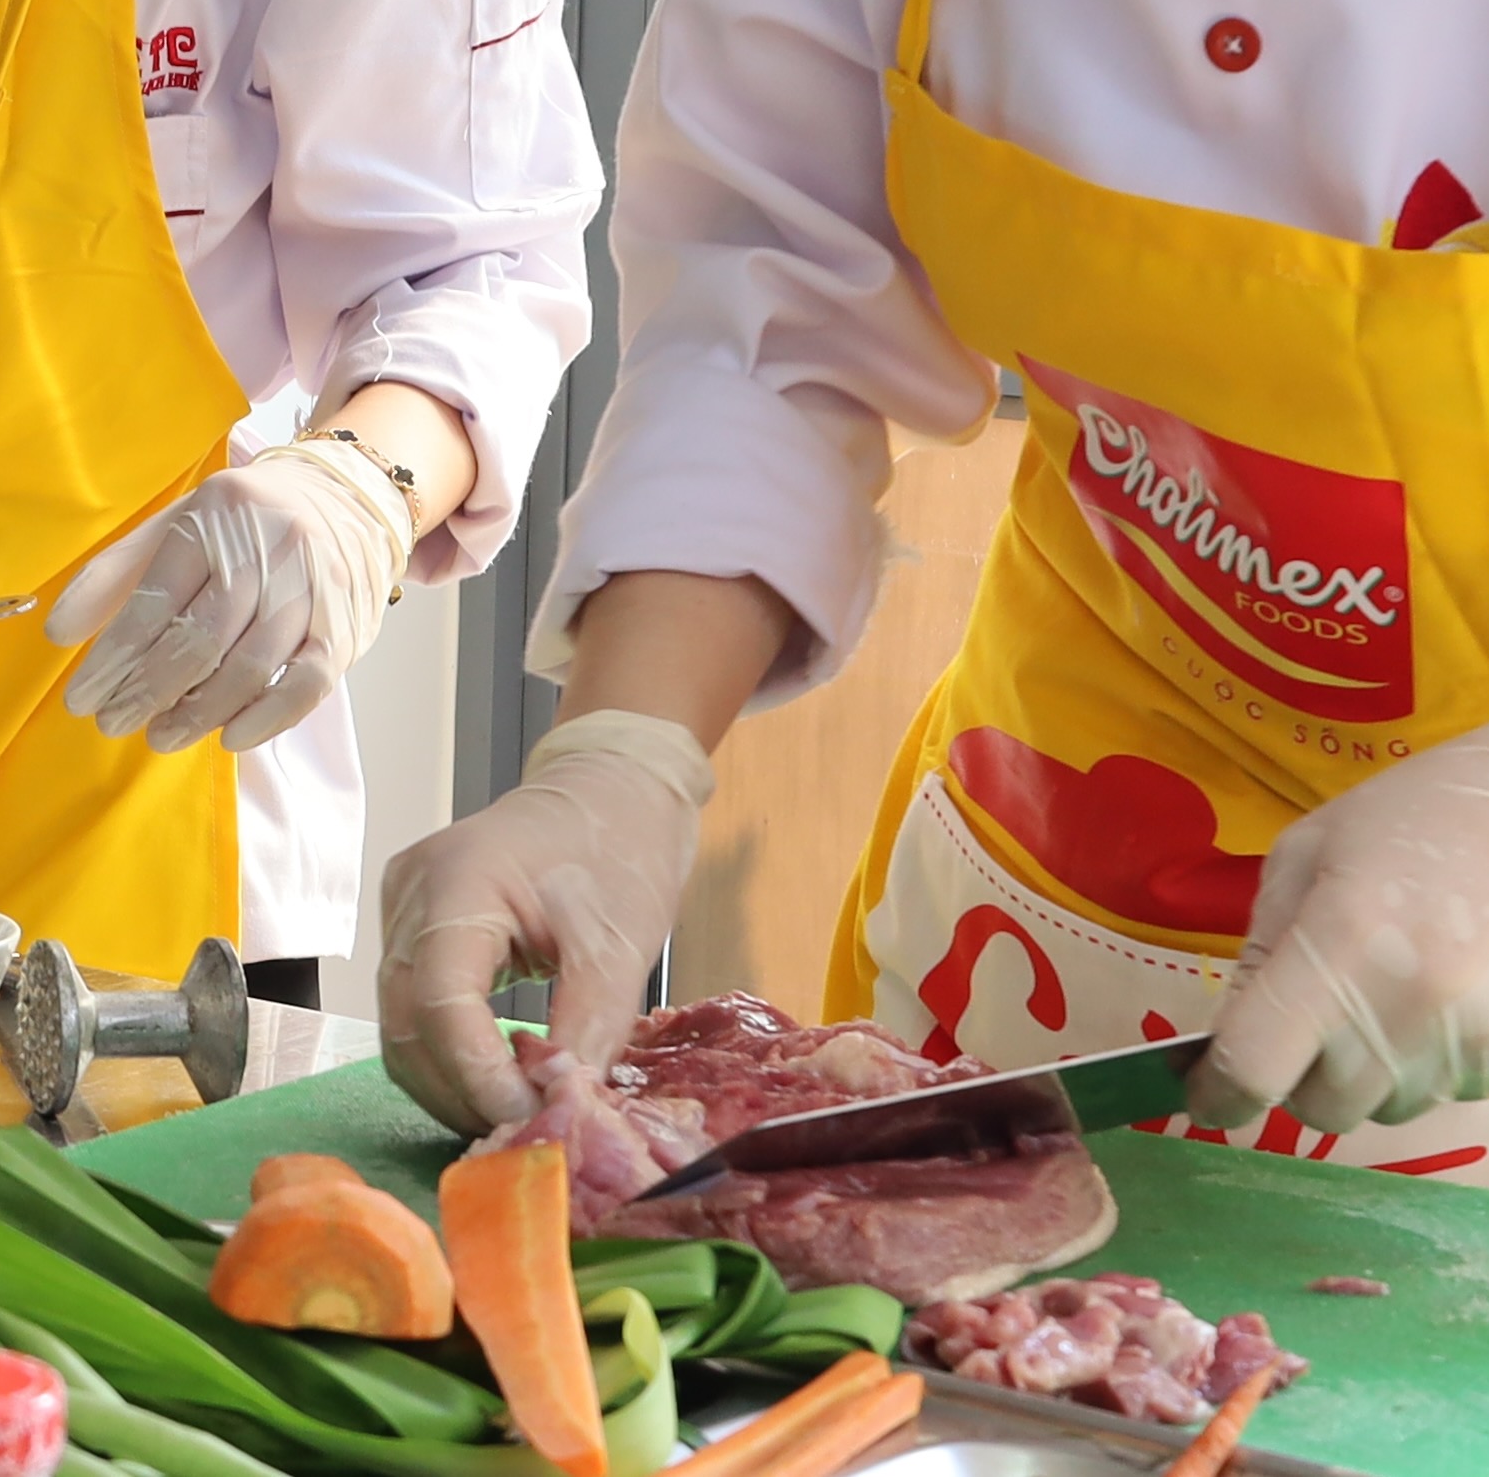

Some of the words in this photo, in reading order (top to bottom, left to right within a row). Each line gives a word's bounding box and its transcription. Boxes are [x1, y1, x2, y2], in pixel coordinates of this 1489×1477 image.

[1233, 590, 1370, 646] FOODS
[1161, 635, 1265, 721] CUỘC
[1292, 725, 1412, 763] SỐNG
